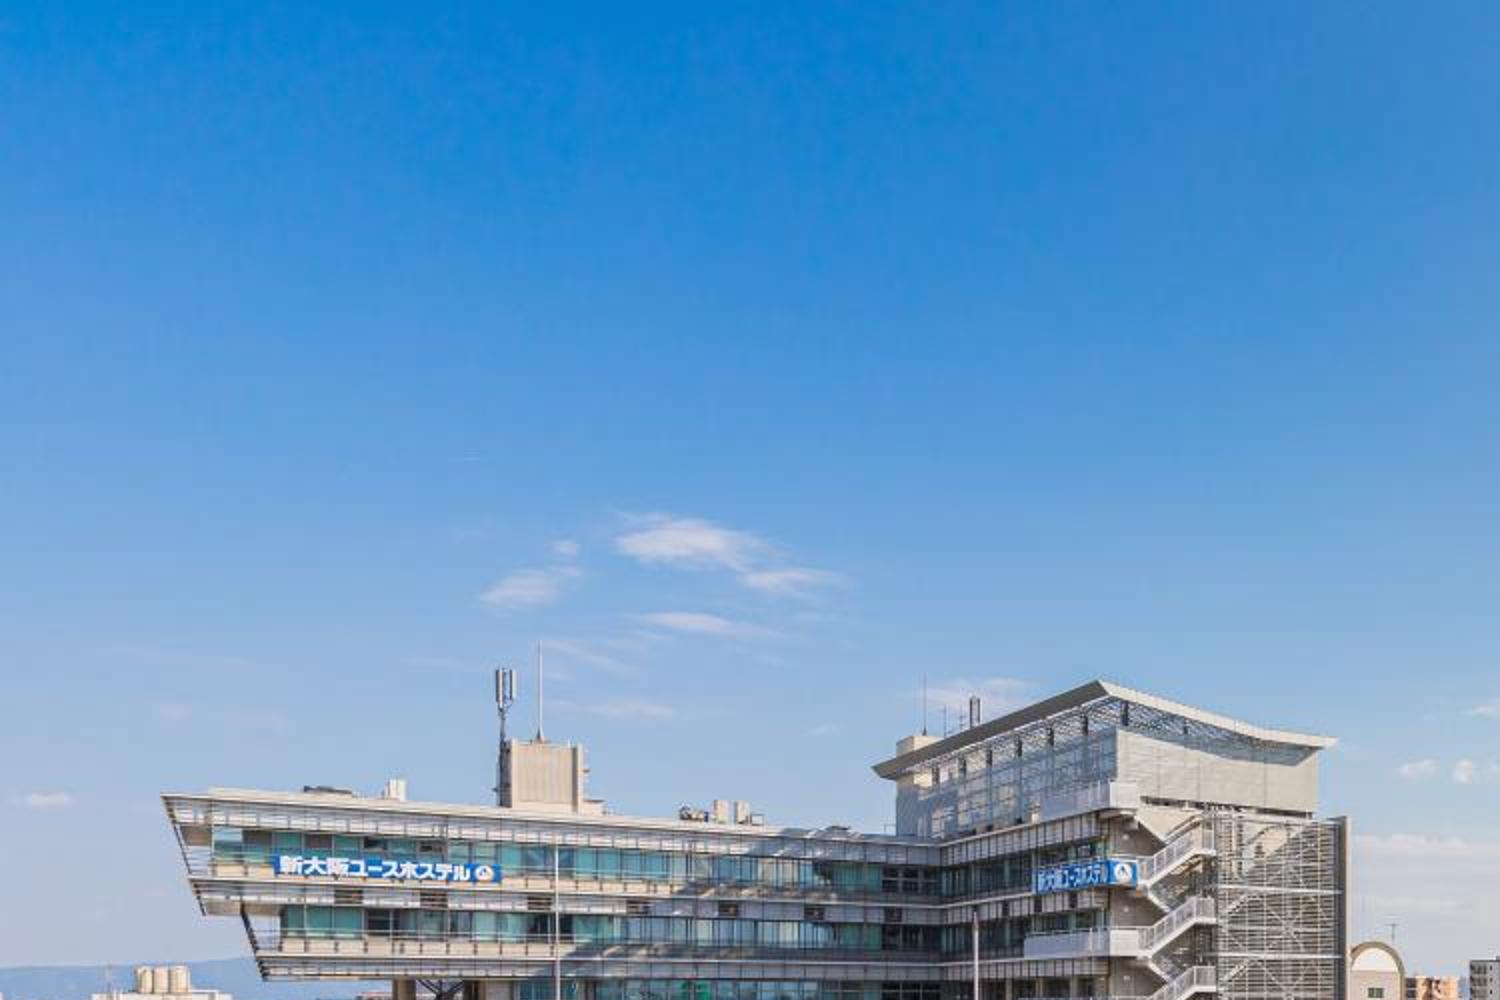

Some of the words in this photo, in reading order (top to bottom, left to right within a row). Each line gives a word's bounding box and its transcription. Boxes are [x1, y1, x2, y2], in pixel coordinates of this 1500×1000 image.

[279, 855, 470, 881] 新大阪ユースホステル
